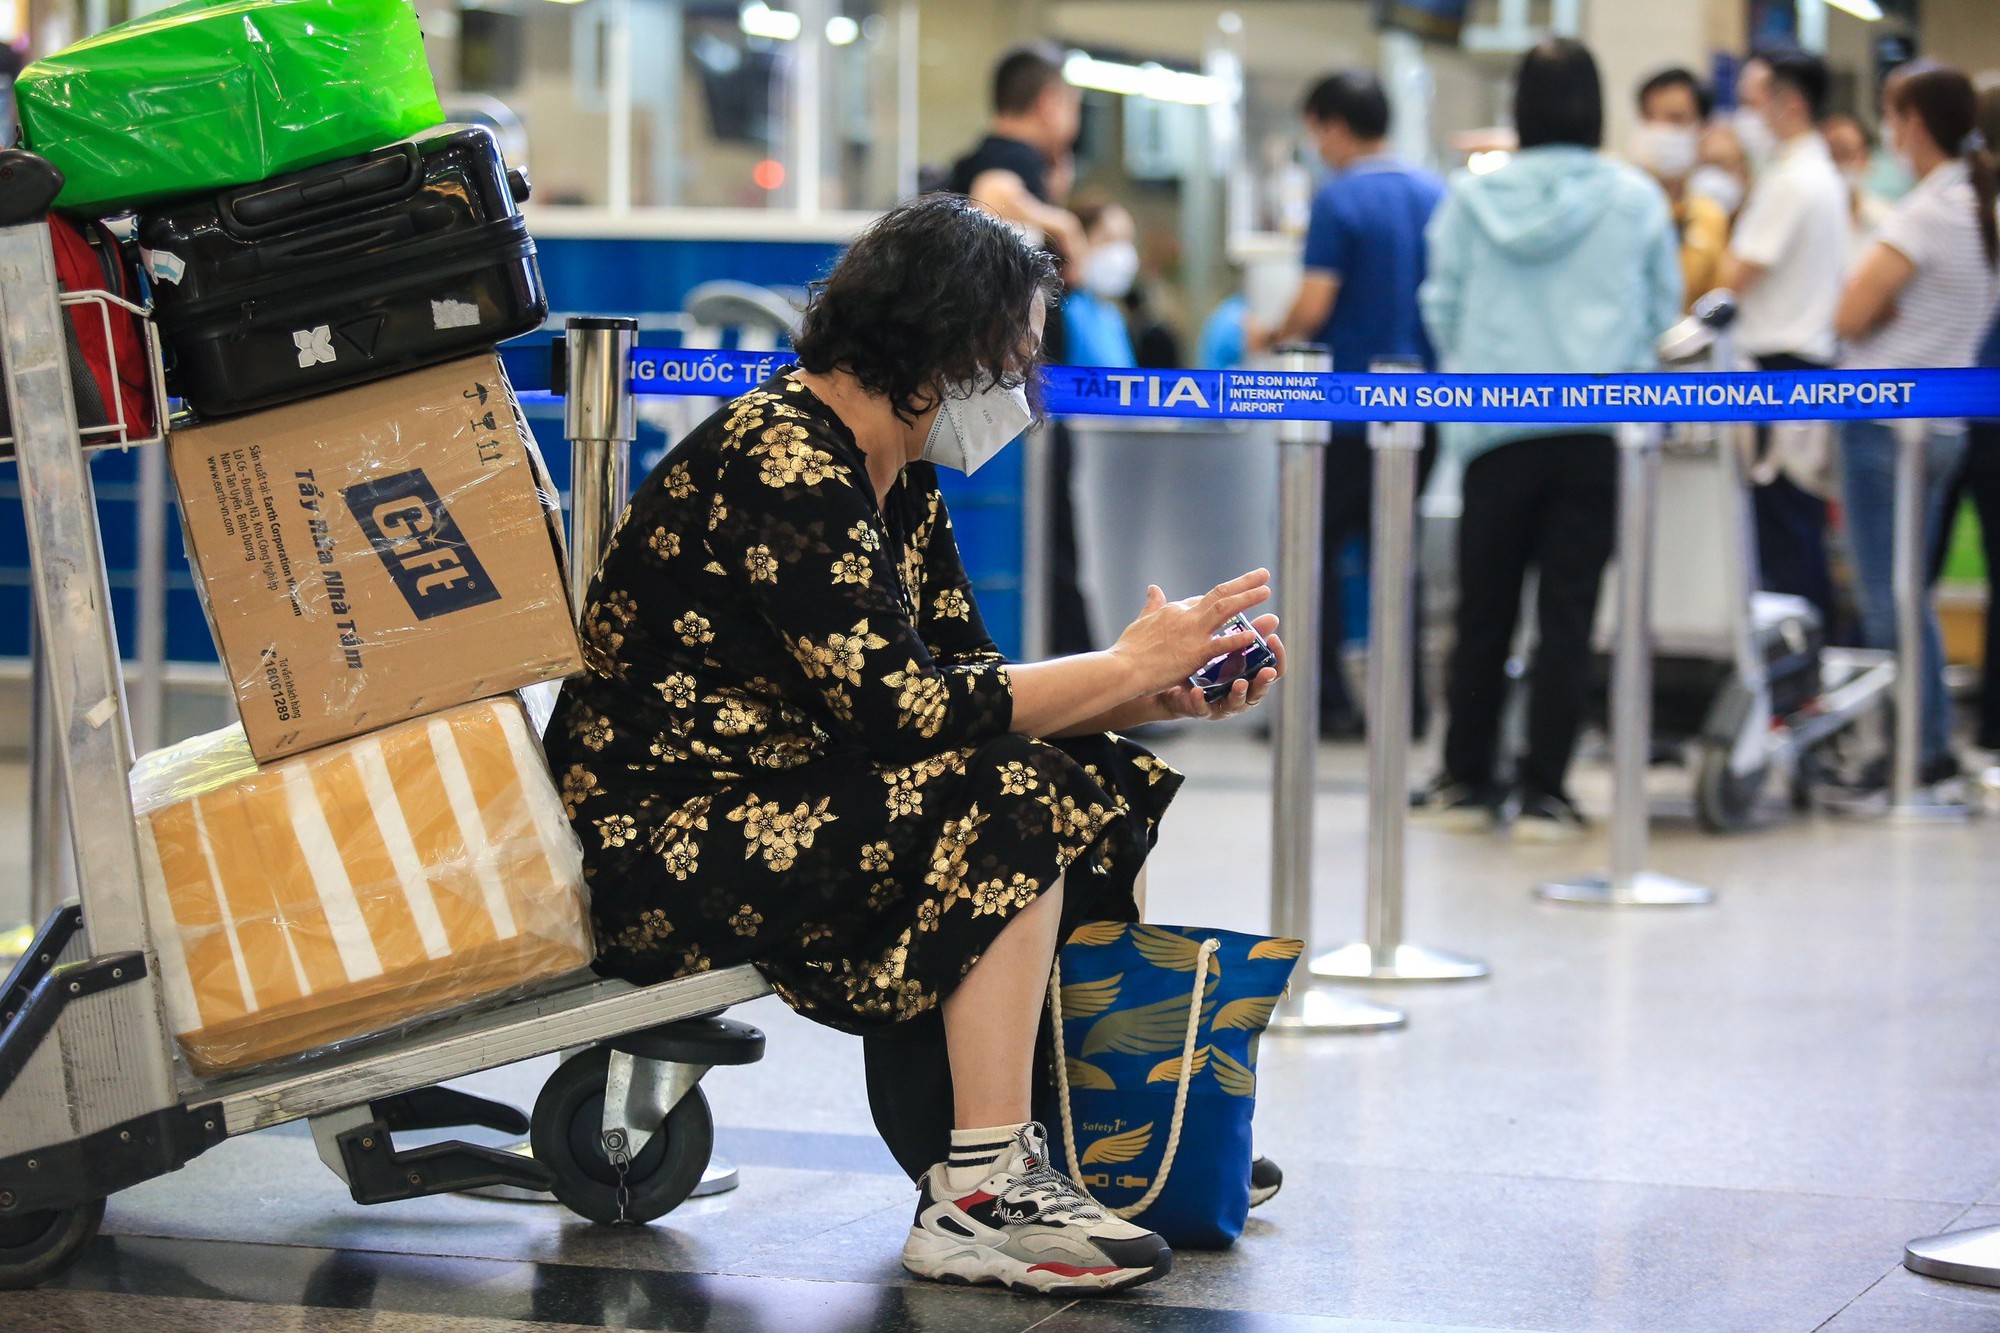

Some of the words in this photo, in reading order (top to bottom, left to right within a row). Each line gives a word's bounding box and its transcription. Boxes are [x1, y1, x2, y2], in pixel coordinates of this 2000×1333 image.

[662, 354, 734, 383] QUỐC
[741, 356, 775, 384] TẾ
[1107, 375, 1210, 408] TIA
[1230, 375, 1256, 386] TAN
[1257, 375, 1284, 387] SON
[1286, 376, 1319, 388] NHAT
[1230, 388, 1327, 401] INTERNATIONAL
[1355, 386, 1408, 407] TAN
[1415, 386, 1473, 408] SON
[1482, 386, 1554, 408] NHAT
[1562, 384, 1783, 408] INTERNATIONAL
[1789, 382, 1917, 405] AIRPORT
[1230, 401, 1285, 413] AIRPORT
[220, 453, 232, 469] Nam
[233, 449, 243, 460] Lô
[249, 444, 260, 461] Sản
[237, 461, 248, 472] C6
[254, 462, 268, 479] xuất
[225, 470, 238, 487] Tân
[207, 456, 235, 537] www.earth-vn.com
[229, 488, 243, 515] Uyên,
[242, 477, 256, 506] Đường
[249, 506, 261, 522] N3,
[263, 496, 277, 522] Earth
[236, 514, 248, 533] Bình
[253, 522, 265, 539] Khu
[242, 534, 257, 562] Dương
[256, 539, 270, 562] Công
[270, 523, 292, 577] Corporation
[263, 562, 279, 591] Nghiệp
[286, 577, 302, 617] Viam
[322, 571, 351, 615] Nhà
[285, 680, 299, 700] khách
[291, 701, 302, 719] hàng
